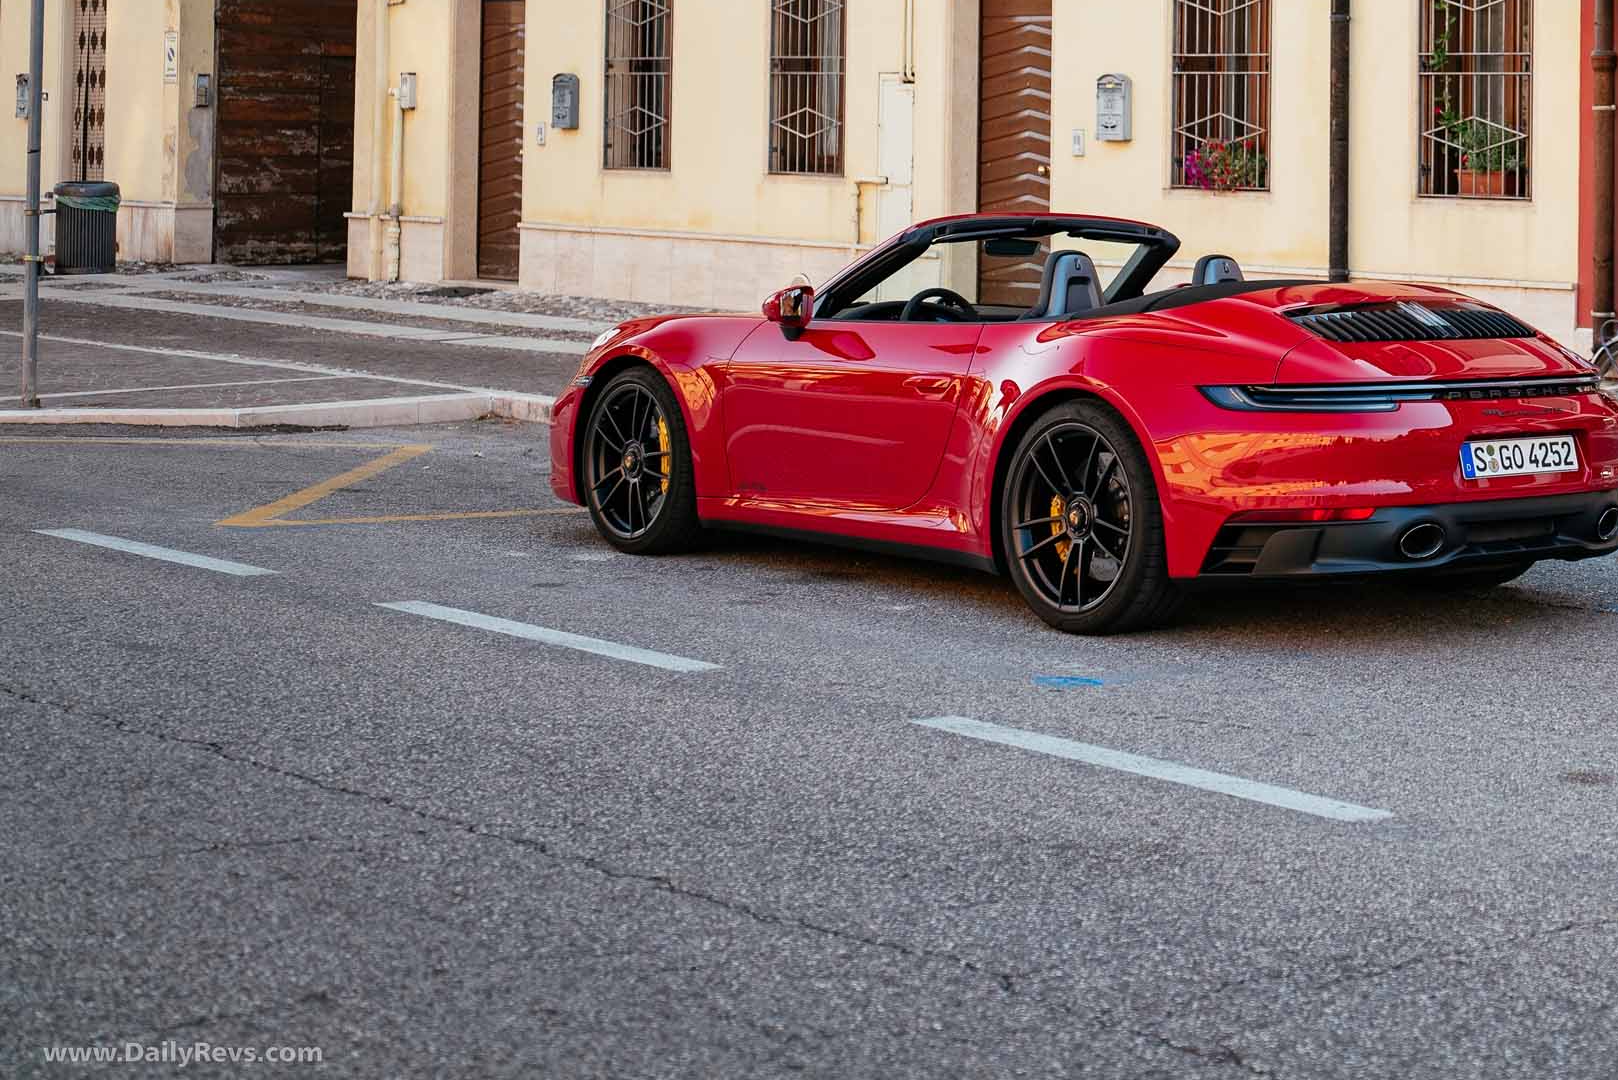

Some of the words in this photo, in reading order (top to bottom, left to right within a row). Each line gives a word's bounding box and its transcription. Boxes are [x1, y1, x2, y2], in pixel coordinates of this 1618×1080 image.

[1474, 446, 1488, 472] S
[1499, 444, 1525, 471] GO
[1529, 441, 1575, 469] 4252
